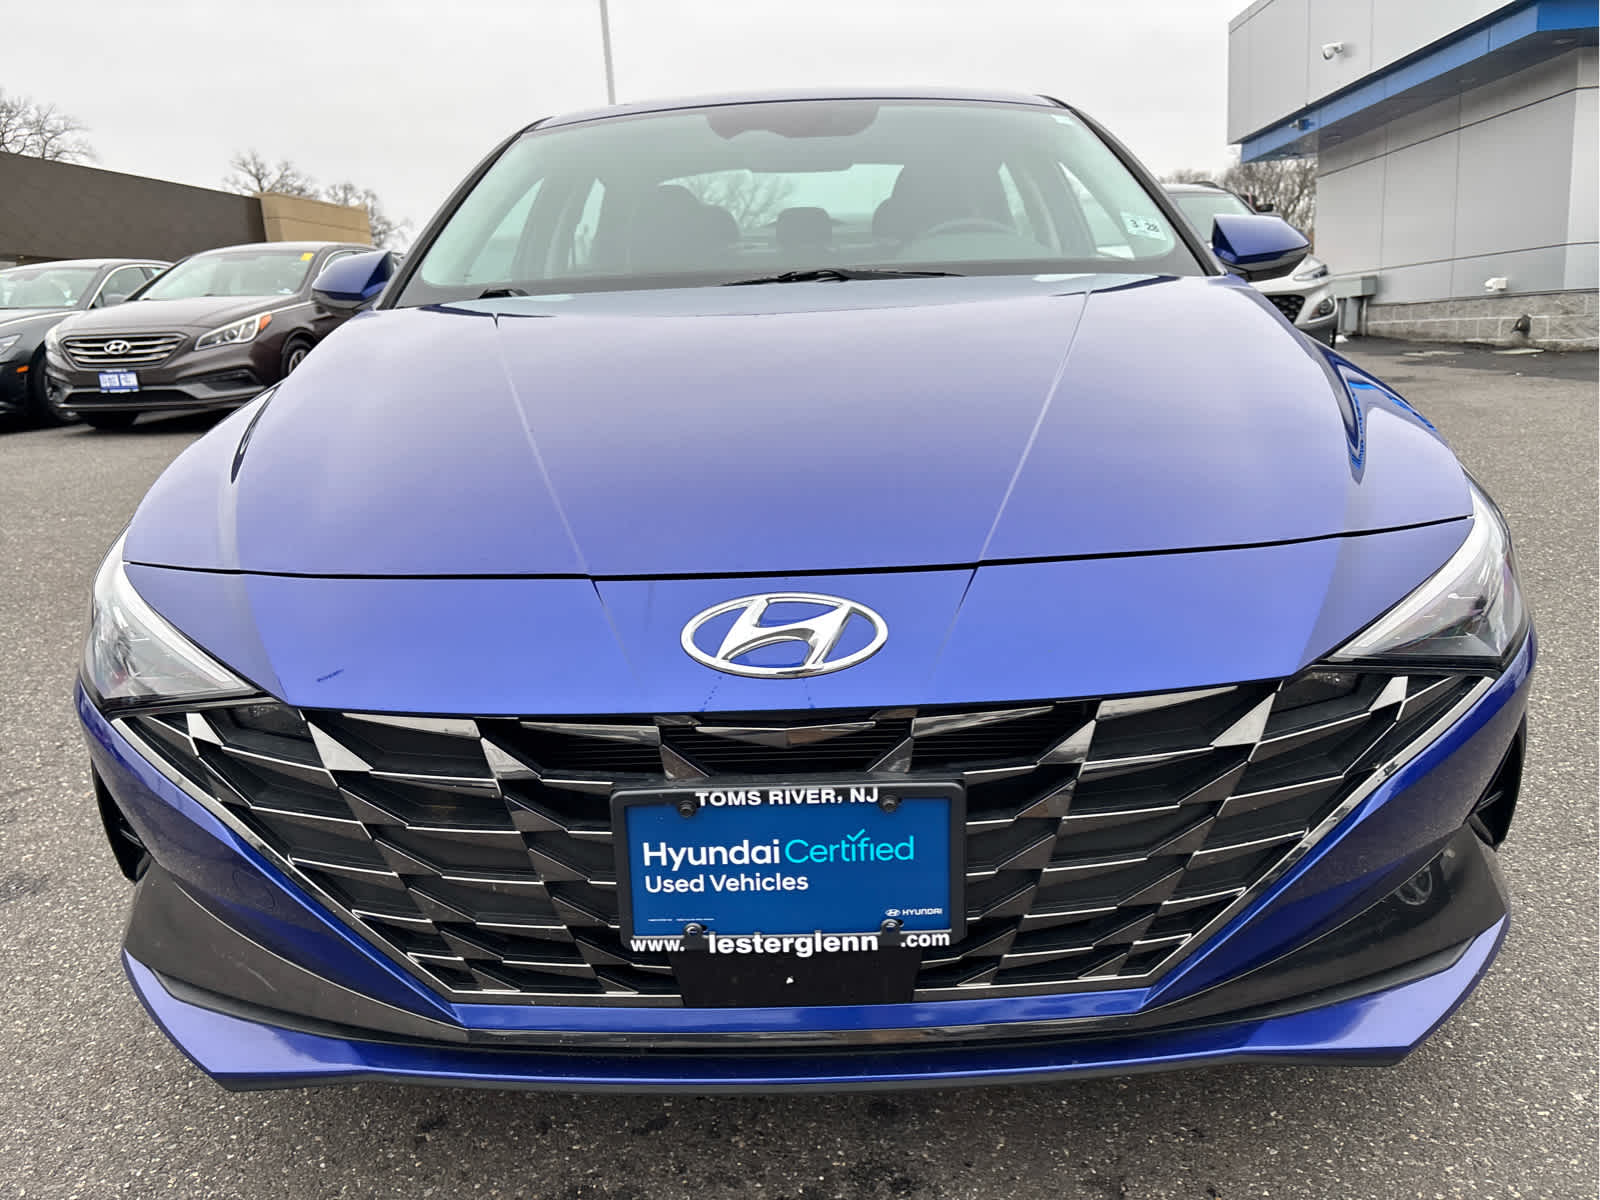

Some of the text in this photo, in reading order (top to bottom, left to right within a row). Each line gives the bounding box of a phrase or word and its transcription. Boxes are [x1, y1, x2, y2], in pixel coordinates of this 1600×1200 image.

[695, 787, 879, 807] TOMS RIVER, NJ
[643, 829, 915, 871] Hyundai Certified
[645, 872, 809, 893] Used Vehicles
[902, 907, 943, 916] HYUNDAI
[630, 931, 950, 957] www. lesterglenn .com
